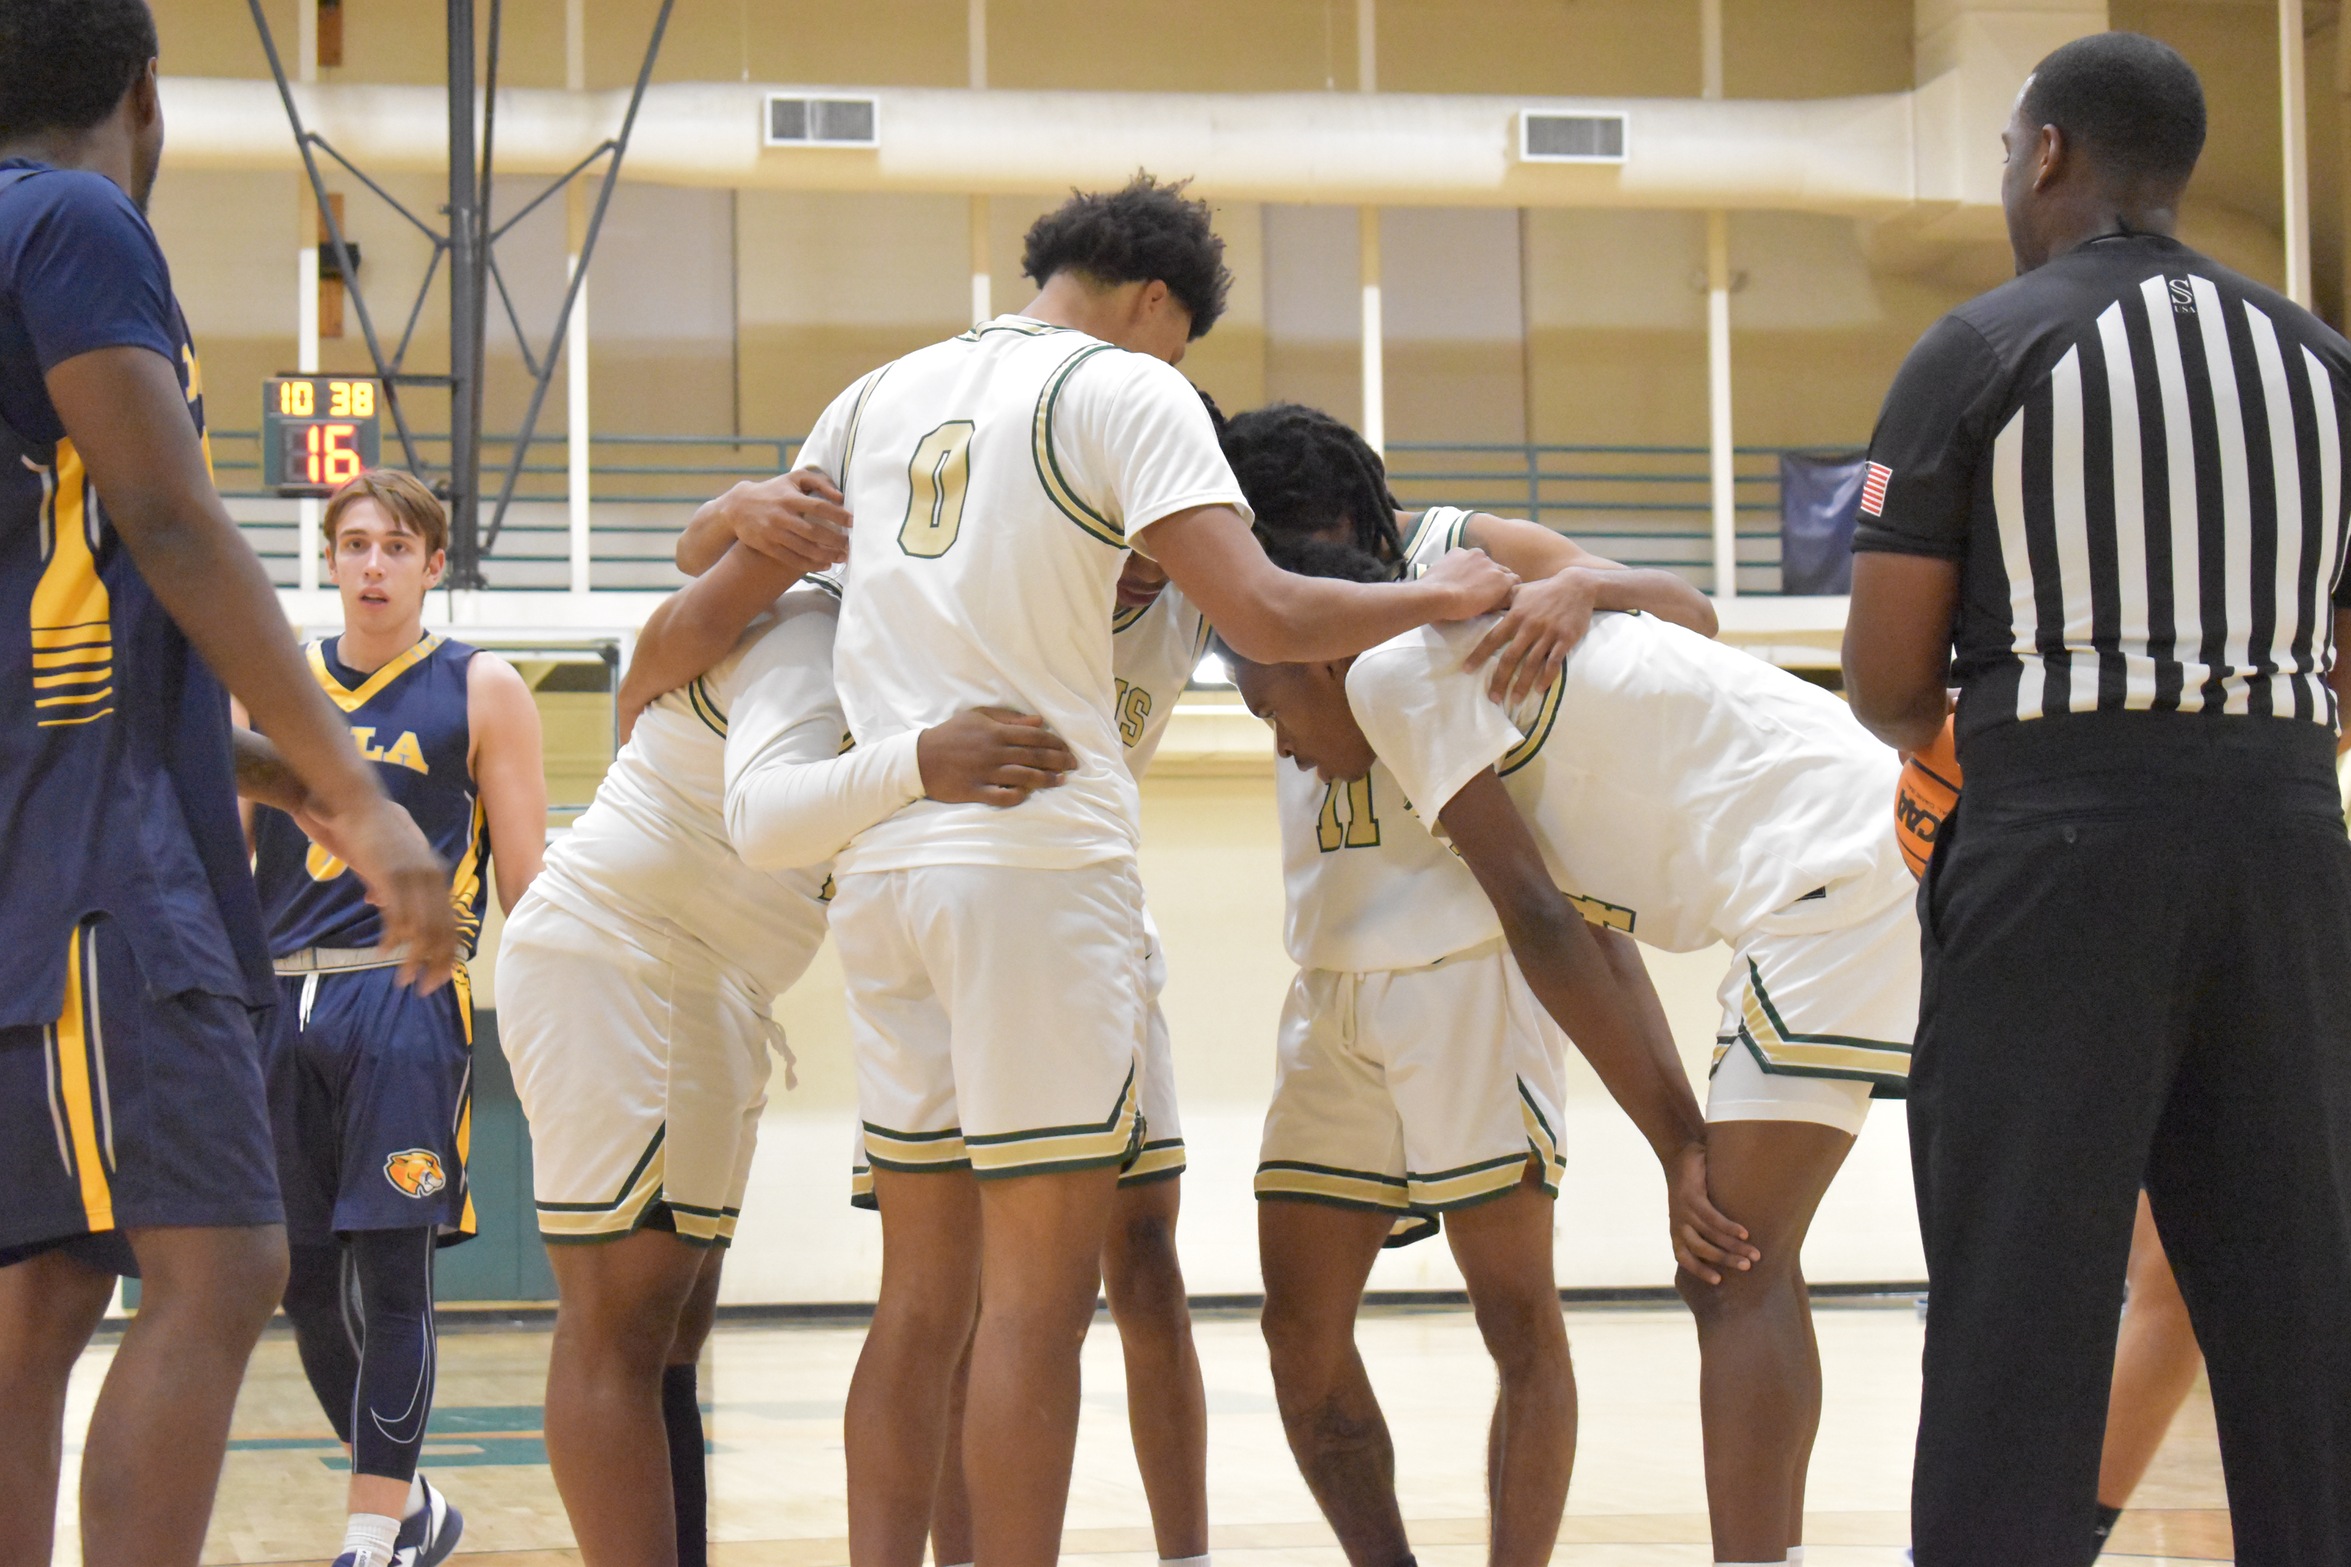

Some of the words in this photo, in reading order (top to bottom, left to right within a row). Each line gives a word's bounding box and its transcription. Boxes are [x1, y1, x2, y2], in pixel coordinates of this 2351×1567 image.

[2174, 305, 2196, 313] USA
[281, 381, 314, 416] 10
[329, 382, 374, 416] 38
[307, 424, 361, 484] 16
[897, 419, 975, 559] 0
[350, 726, 429, 775] LA
[1897, 788, 1941, 843] CAA
